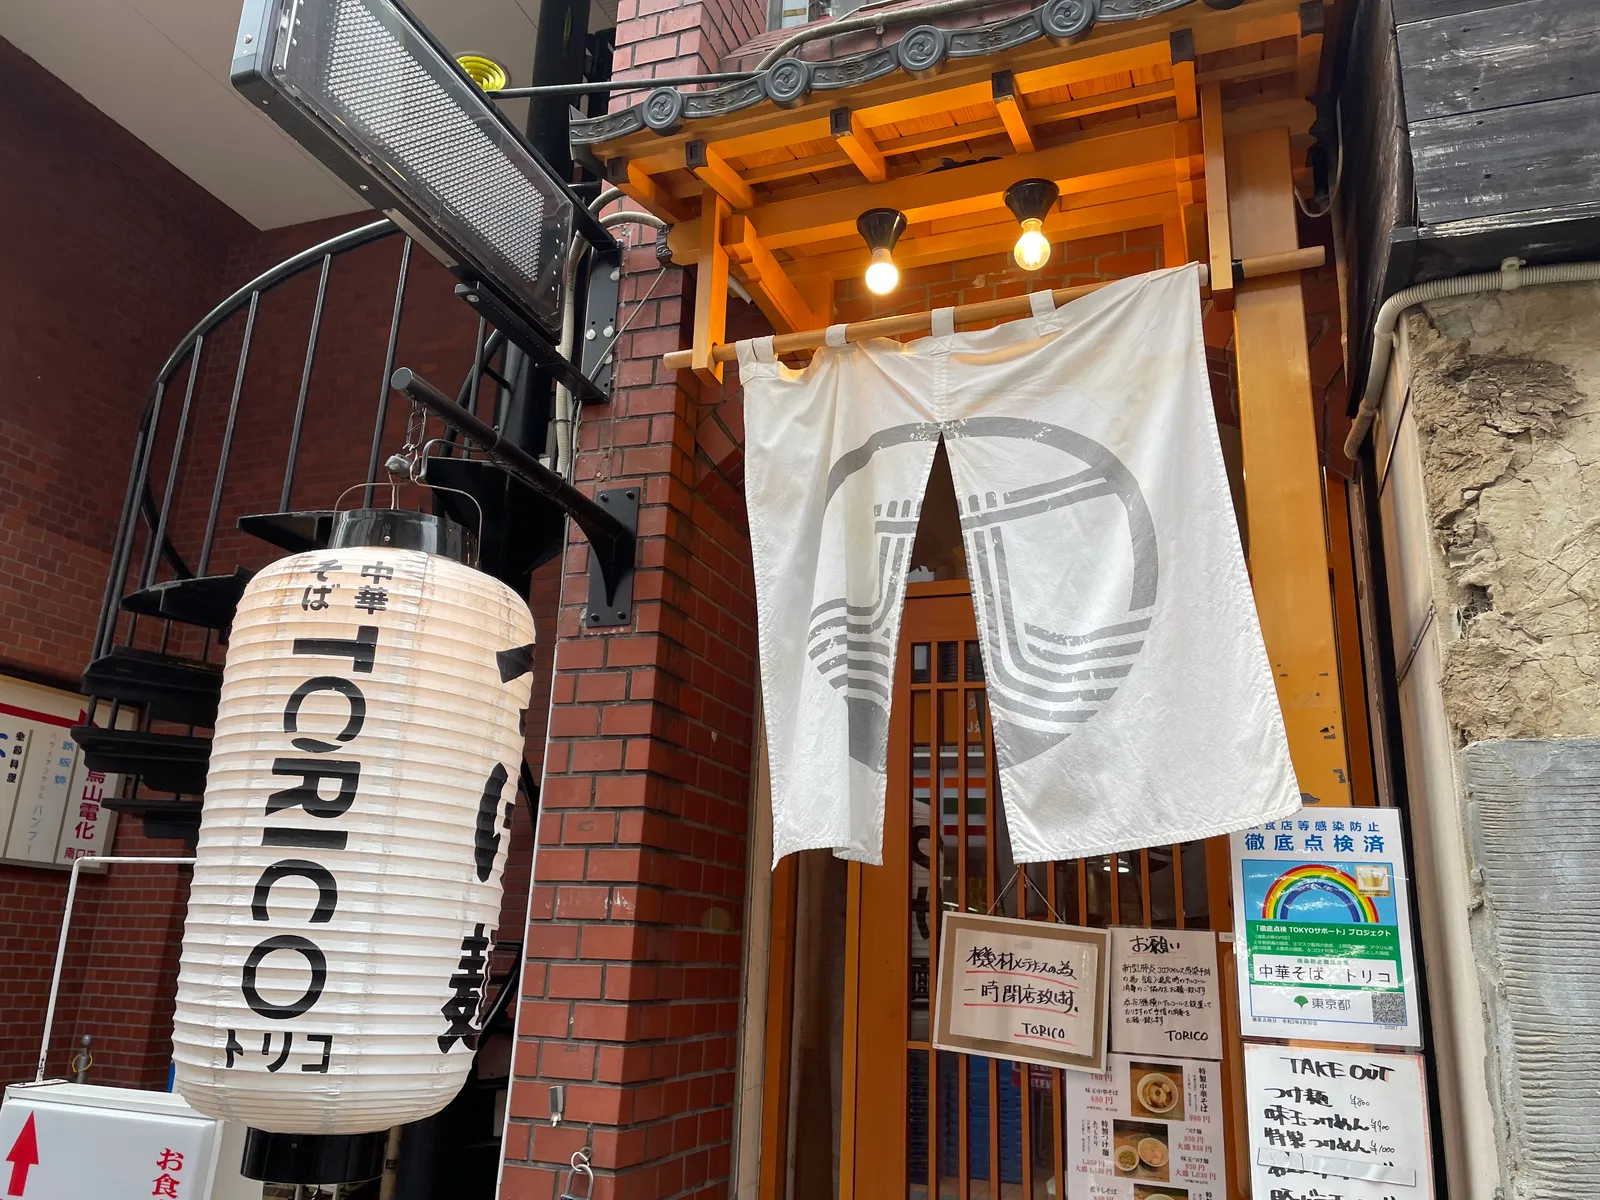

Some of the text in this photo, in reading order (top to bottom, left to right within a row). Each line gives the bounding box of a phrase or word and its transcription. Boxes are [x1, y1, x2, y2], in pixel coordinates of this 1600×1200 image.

[301, 559, 342, 611] そば
[354, 561, 393, 615] 中華
[242, 625, 379, 1019] TORICO
[1245, 833, 1385, 853] 徹底点検済
[1130, 935, 1181, 954] お願い
[1259, 964, 1391, 984] 中華そば トリコ
[1312, 997, 1351, 1011] 東京都
[1021, 1022, 1065, 1039] TORICO
[1167, 1030, 1209, 1042] TORICO
[225, 1028, 334, 1074] トリコ
[1279, 1056, 1396, 1082] TAKE OUT
[1264, 1086, 1333, 1108] つけ麺
